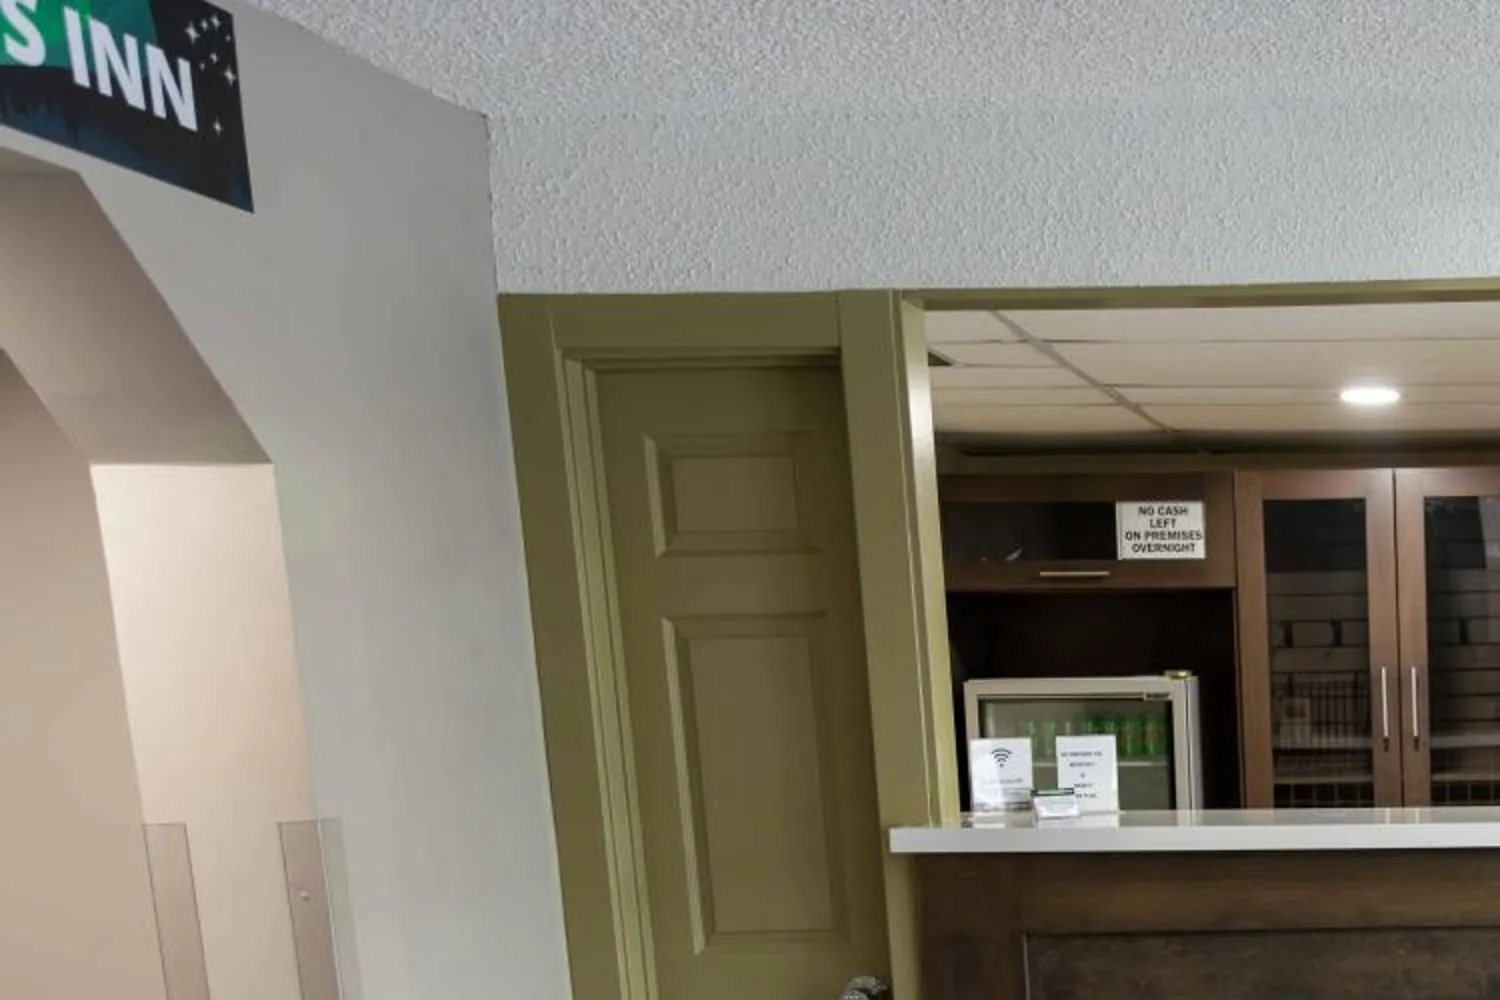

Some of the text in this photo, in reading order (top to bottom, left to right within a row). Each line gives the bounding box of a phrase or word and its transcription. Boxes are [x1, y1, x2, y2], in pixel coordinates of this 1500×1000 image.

[63, 5, 198, 132] INN
[1138, 506, 1188, 516] NO CASH
[1149, 518, 1176, 529] LEFT
[1125, 531, 1202, 541] ON PREMISES
[1131, 543, 1195, 553] OVERNIGHT
